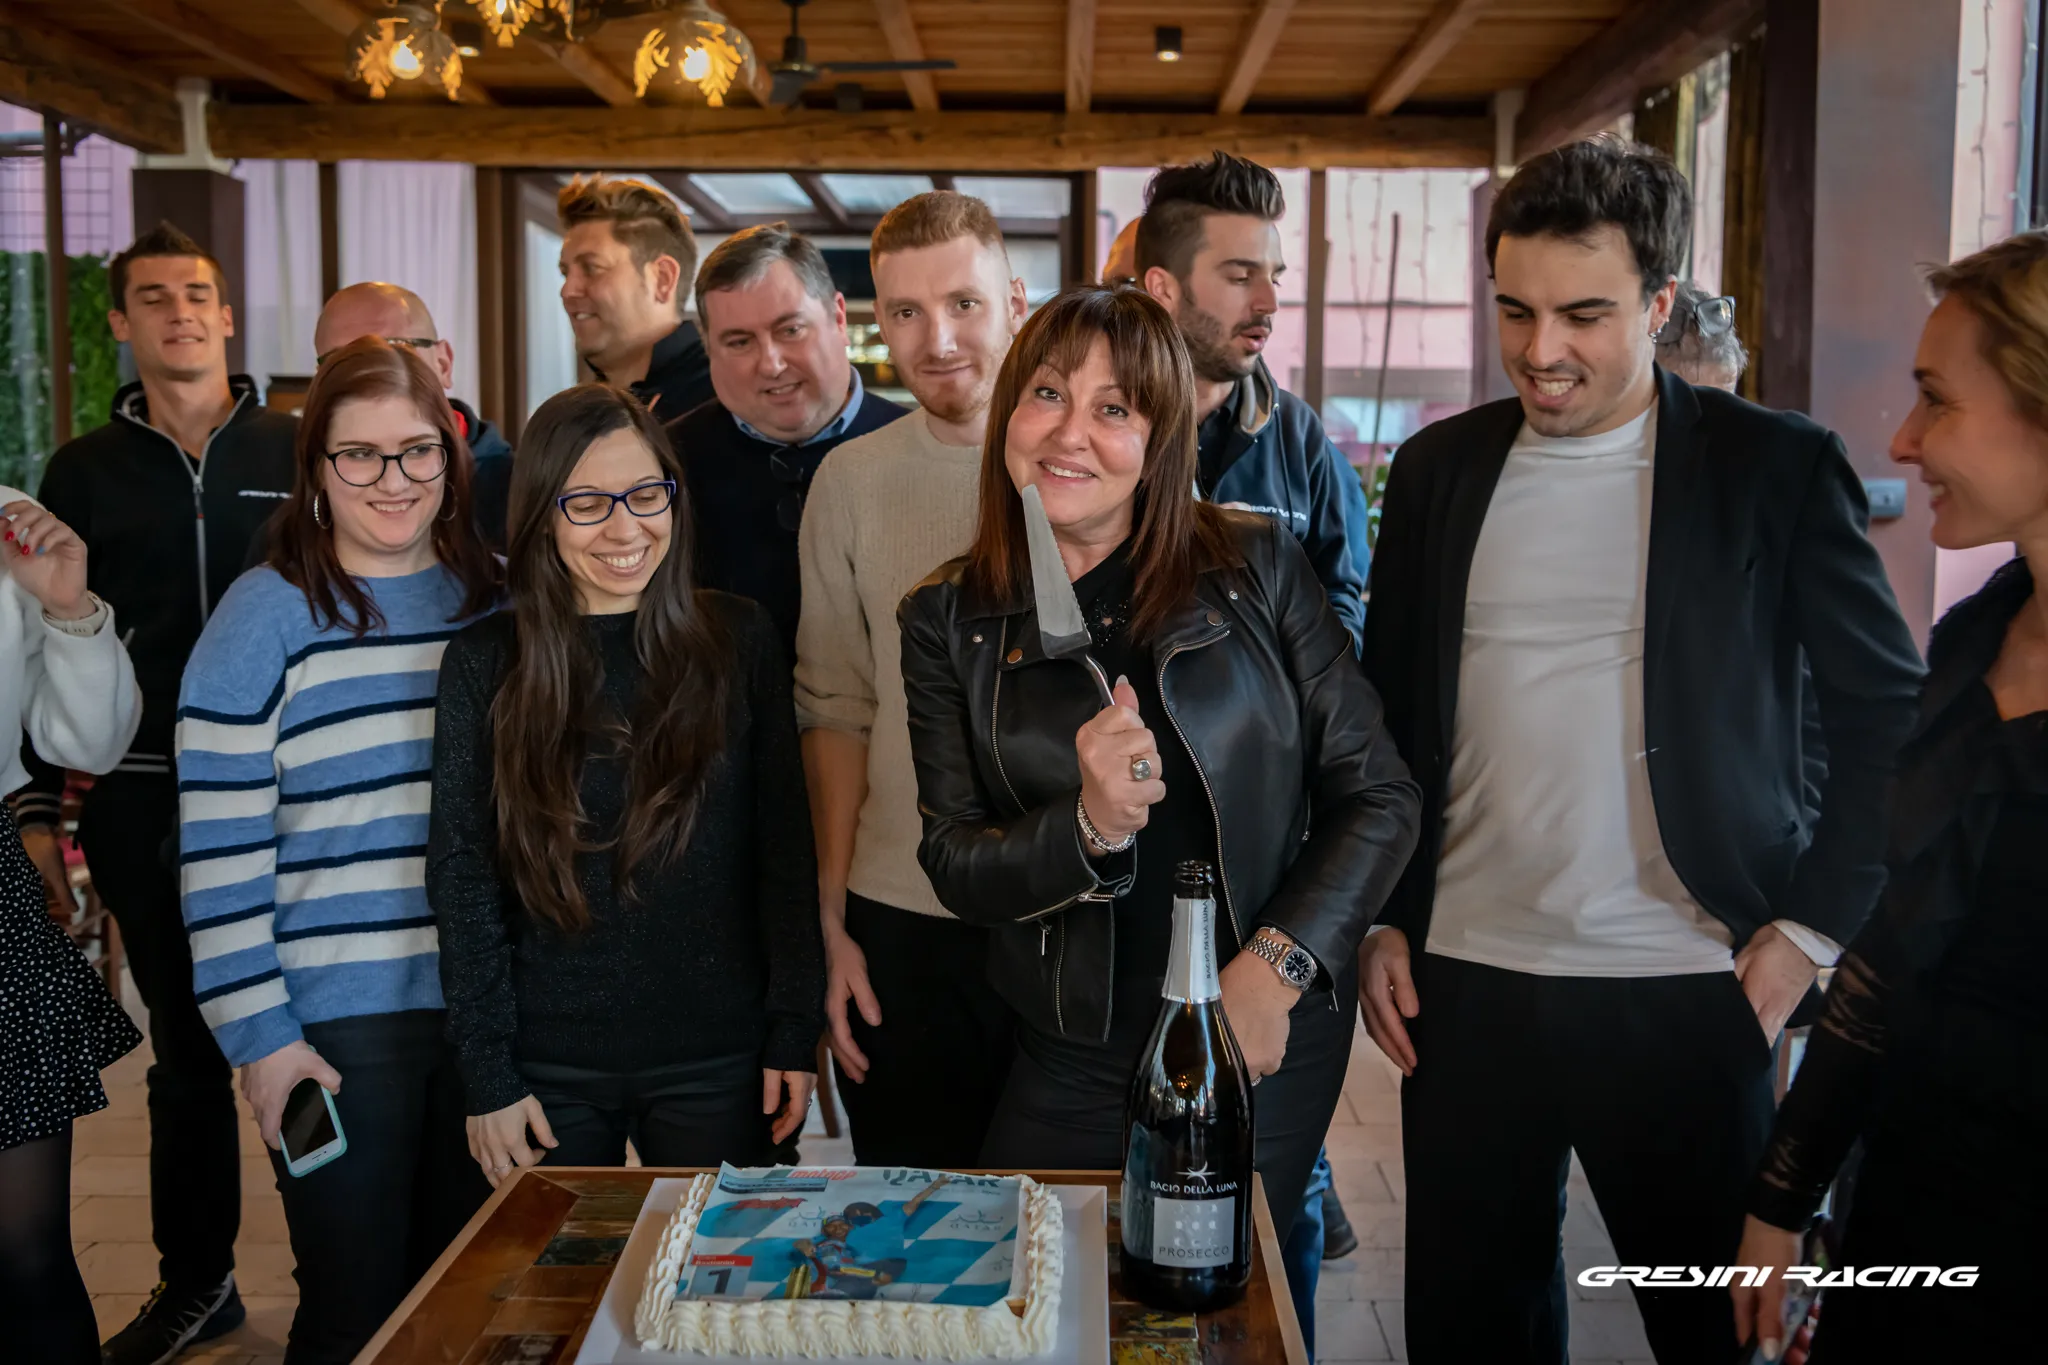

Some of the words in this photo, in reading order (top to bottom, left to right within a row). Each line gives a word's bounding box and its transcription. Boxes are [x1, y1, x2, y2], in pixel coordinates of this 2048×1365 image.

[1150, 1180, 1180, 1193] BACIO
[1183, 1184, 1214, 1195] DELLA
[1216, 1181, 1238, 1193] LUNA
[1159, 1246, 1229, 1259] PROSECCO
[708, 1267, 732, 1295] 1
